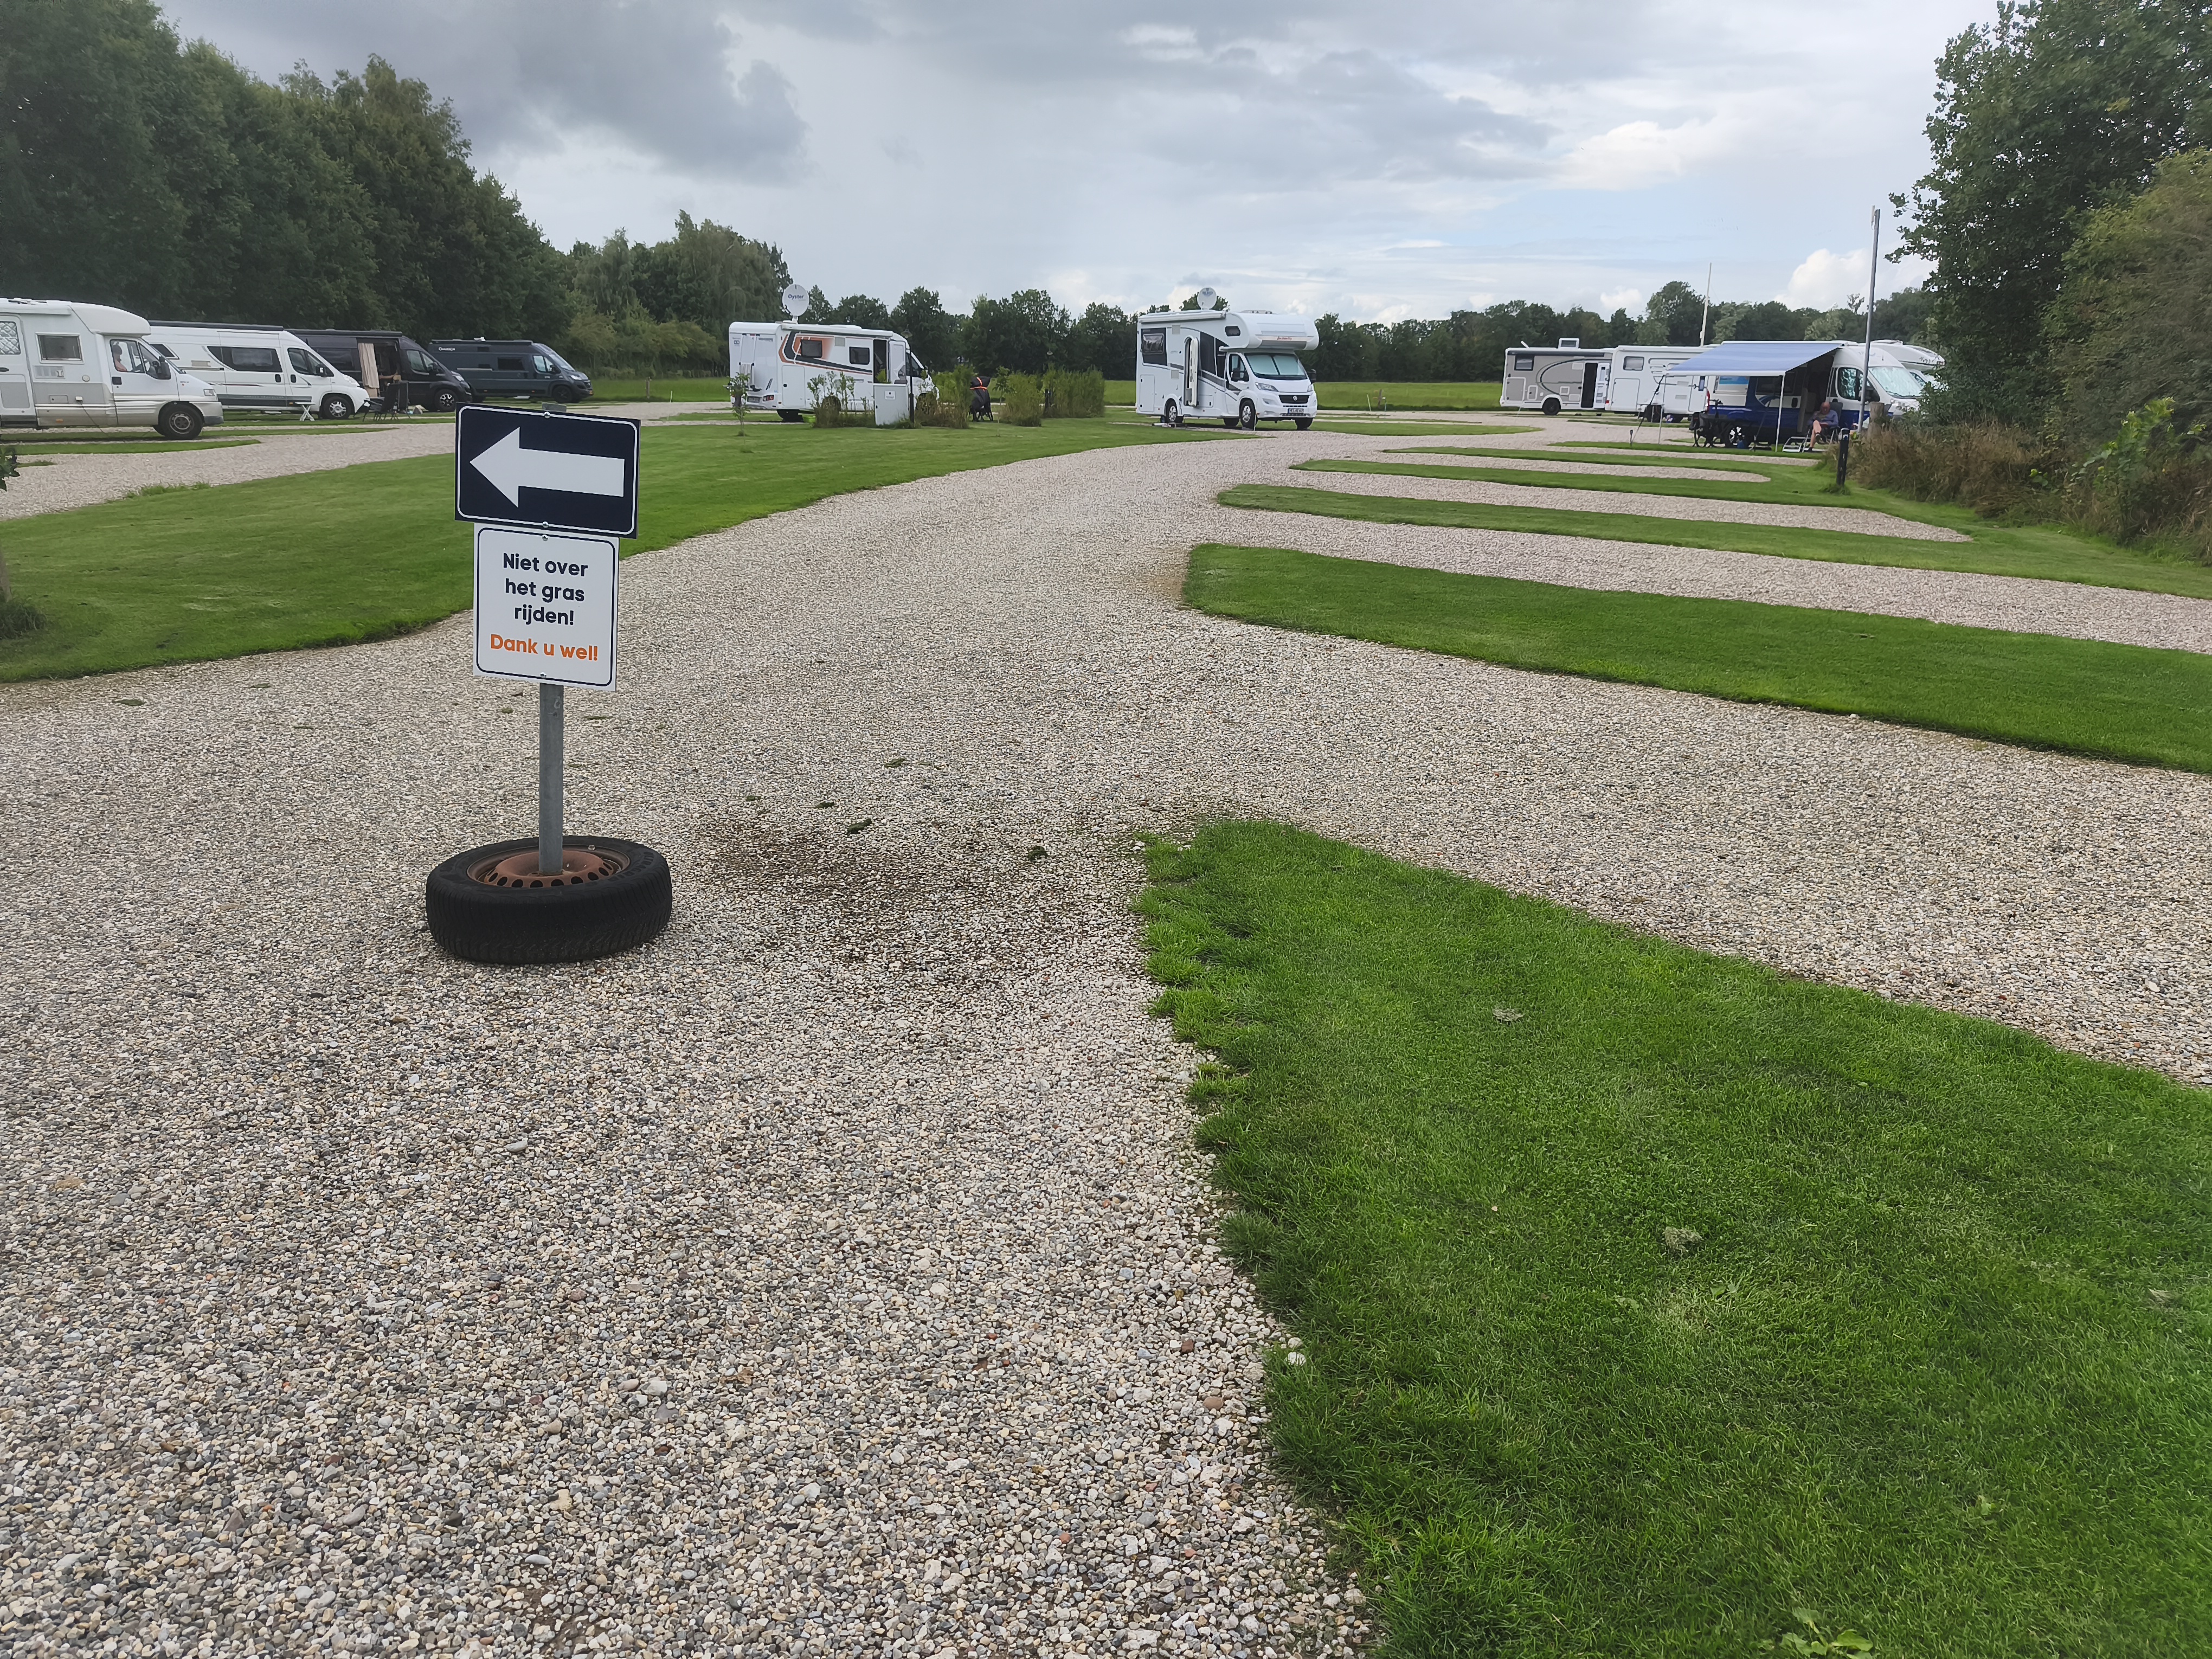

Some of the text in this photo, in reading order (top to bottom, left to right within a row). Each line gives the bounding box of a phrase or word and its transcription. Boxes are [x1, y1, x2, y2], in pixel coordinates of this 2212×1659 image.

[504, 553, 588, 577] Niet over
[505, 578, 584, 603] het gras
[515, 604, 574, 625] rijden!
[491, 634, 597, 661] Dank u wel!
